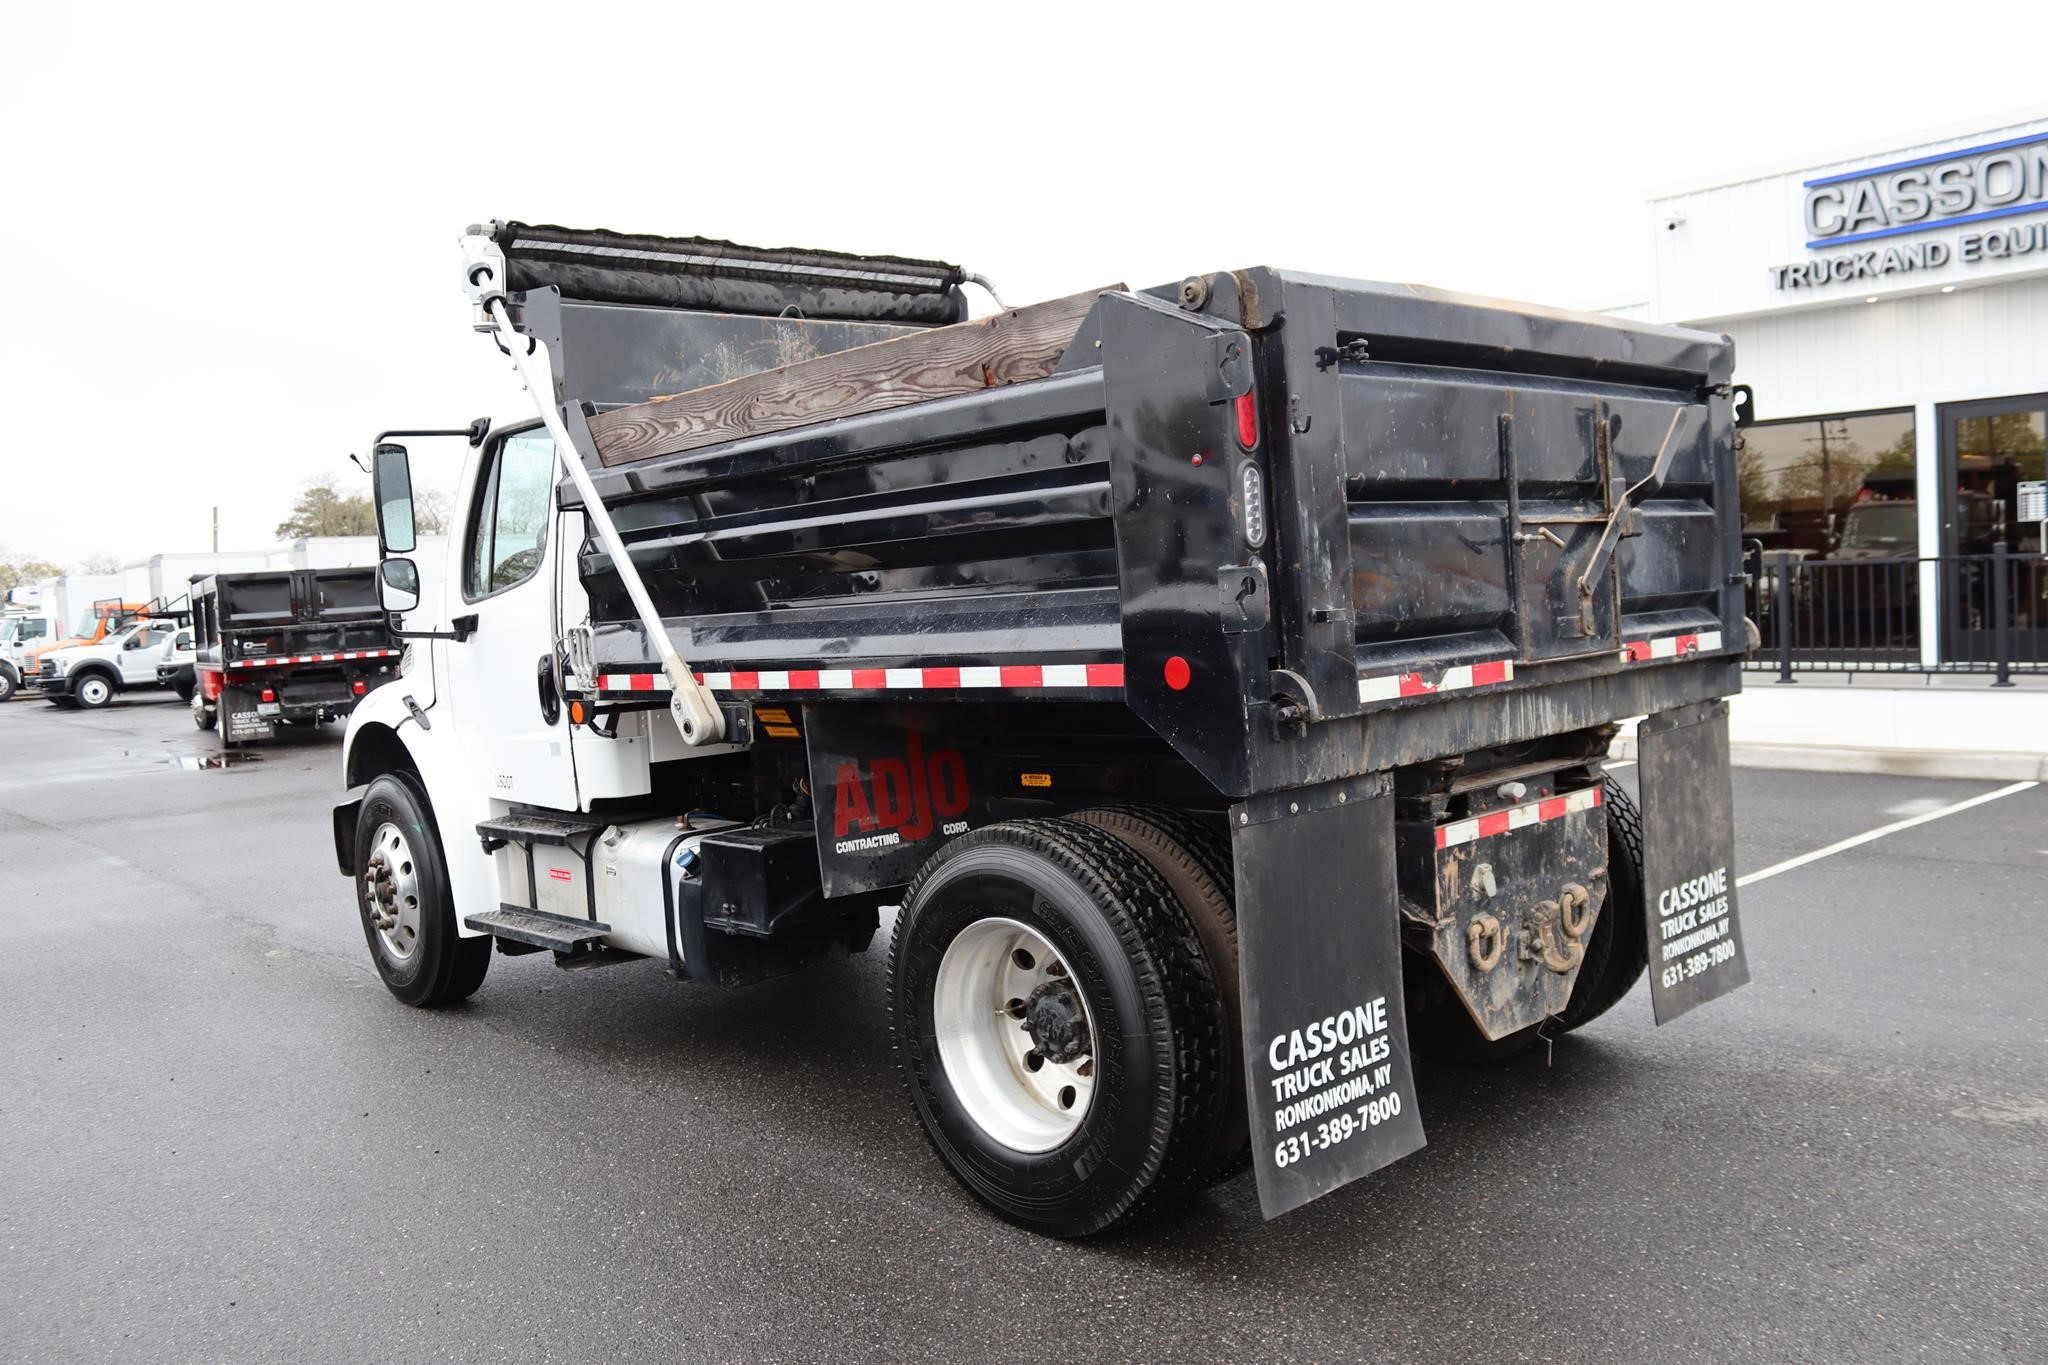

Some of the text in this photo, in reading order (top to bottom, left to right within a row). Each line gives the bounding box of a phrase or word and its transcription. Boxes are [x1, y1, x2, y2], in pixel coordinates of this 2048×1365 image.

[1769, 223, 2048, 289] TRUCK AND EQUI
[834, 722, 970, 840] ADJO
[835, 821, 970, 854] CONTRACTING CORP.
[1658, 867, 1728, 917] CASSONE
[1660, 896, 1729, 940] TRUCK SALES
[1662, 917, 1730, 962] RONKONKOMA, NY
[1662, 938, 1735, 989] 631-389-7800
[1268, 996, 1388, 1071] CASSONE
[1271, 1034, 1390, 1103] TRUCK SALES
[1274, 1063, 1392, 1132] RONKONKOMA, NY
[1274, 1091, 1401, 1168] 631-389-7800
